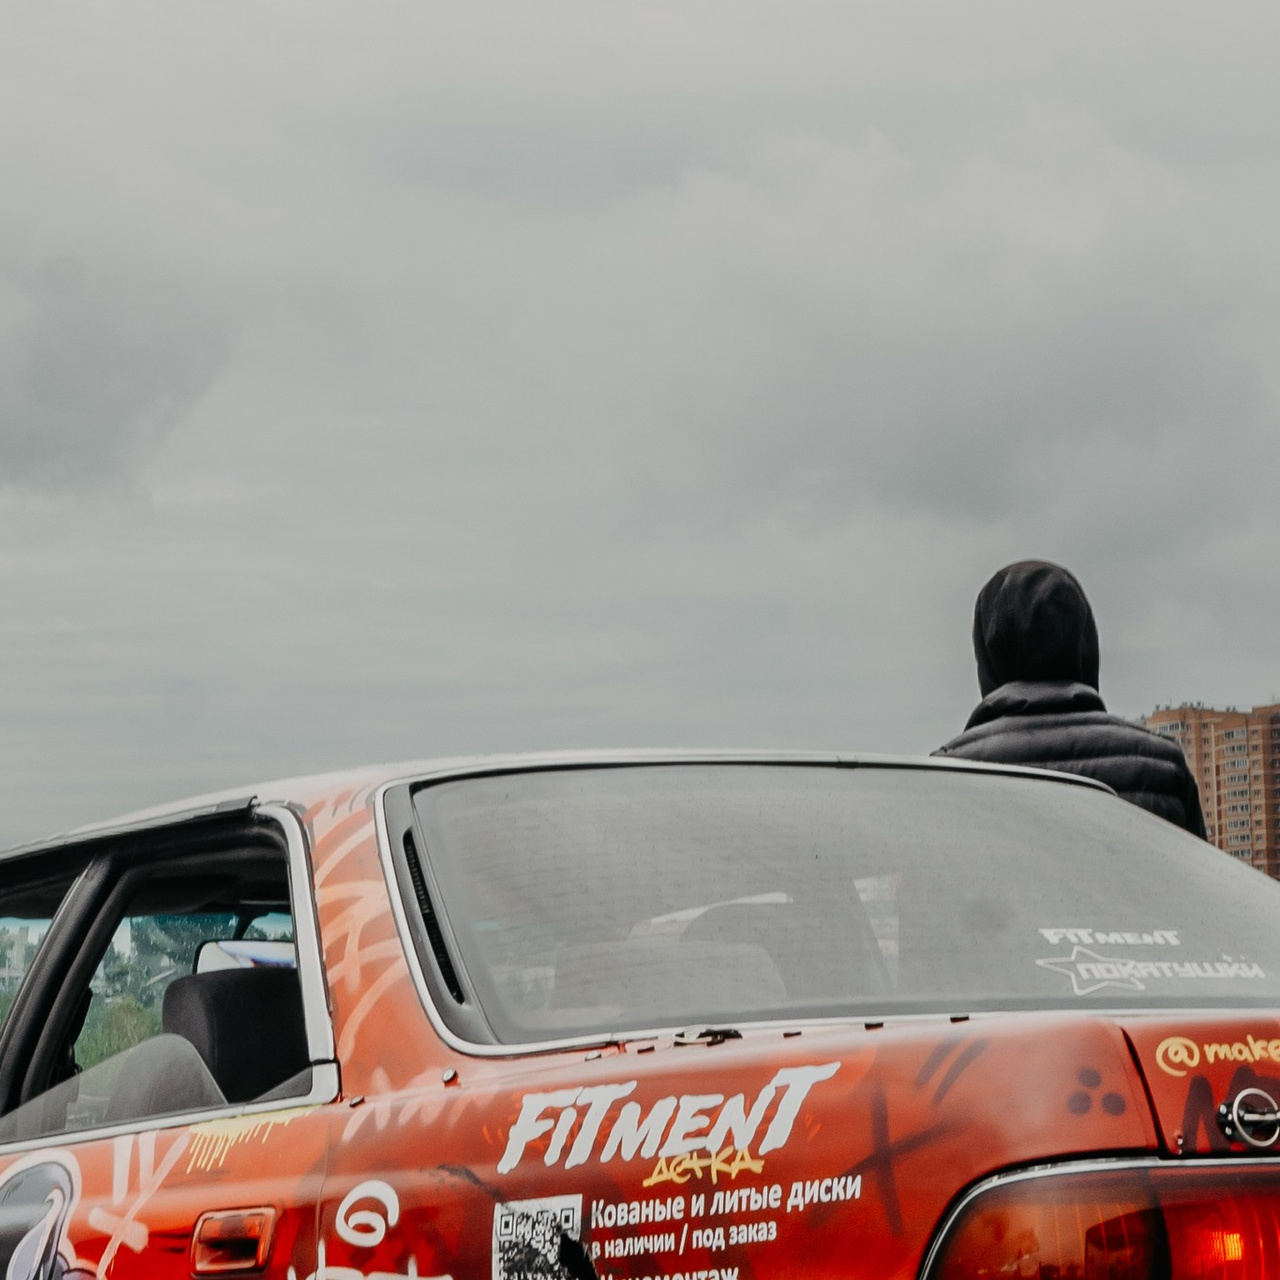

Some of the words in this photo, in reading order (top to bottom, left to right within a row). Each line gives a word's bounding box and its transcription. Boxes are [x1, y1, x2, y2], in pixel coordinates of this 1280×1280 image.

[591, 1194, 685, 1230] Кованые
[690, 1193, 705, 1218] и
[709, 1183, 782, 1216] литые
[786, 1174, 862, 1213] диски
[591, 1240, 601, 1259] в
[604, 1232, 675, 1259] наличии
[692, 1228, 725, 1252] под
[729, 1220, 777, 1246] заказ
